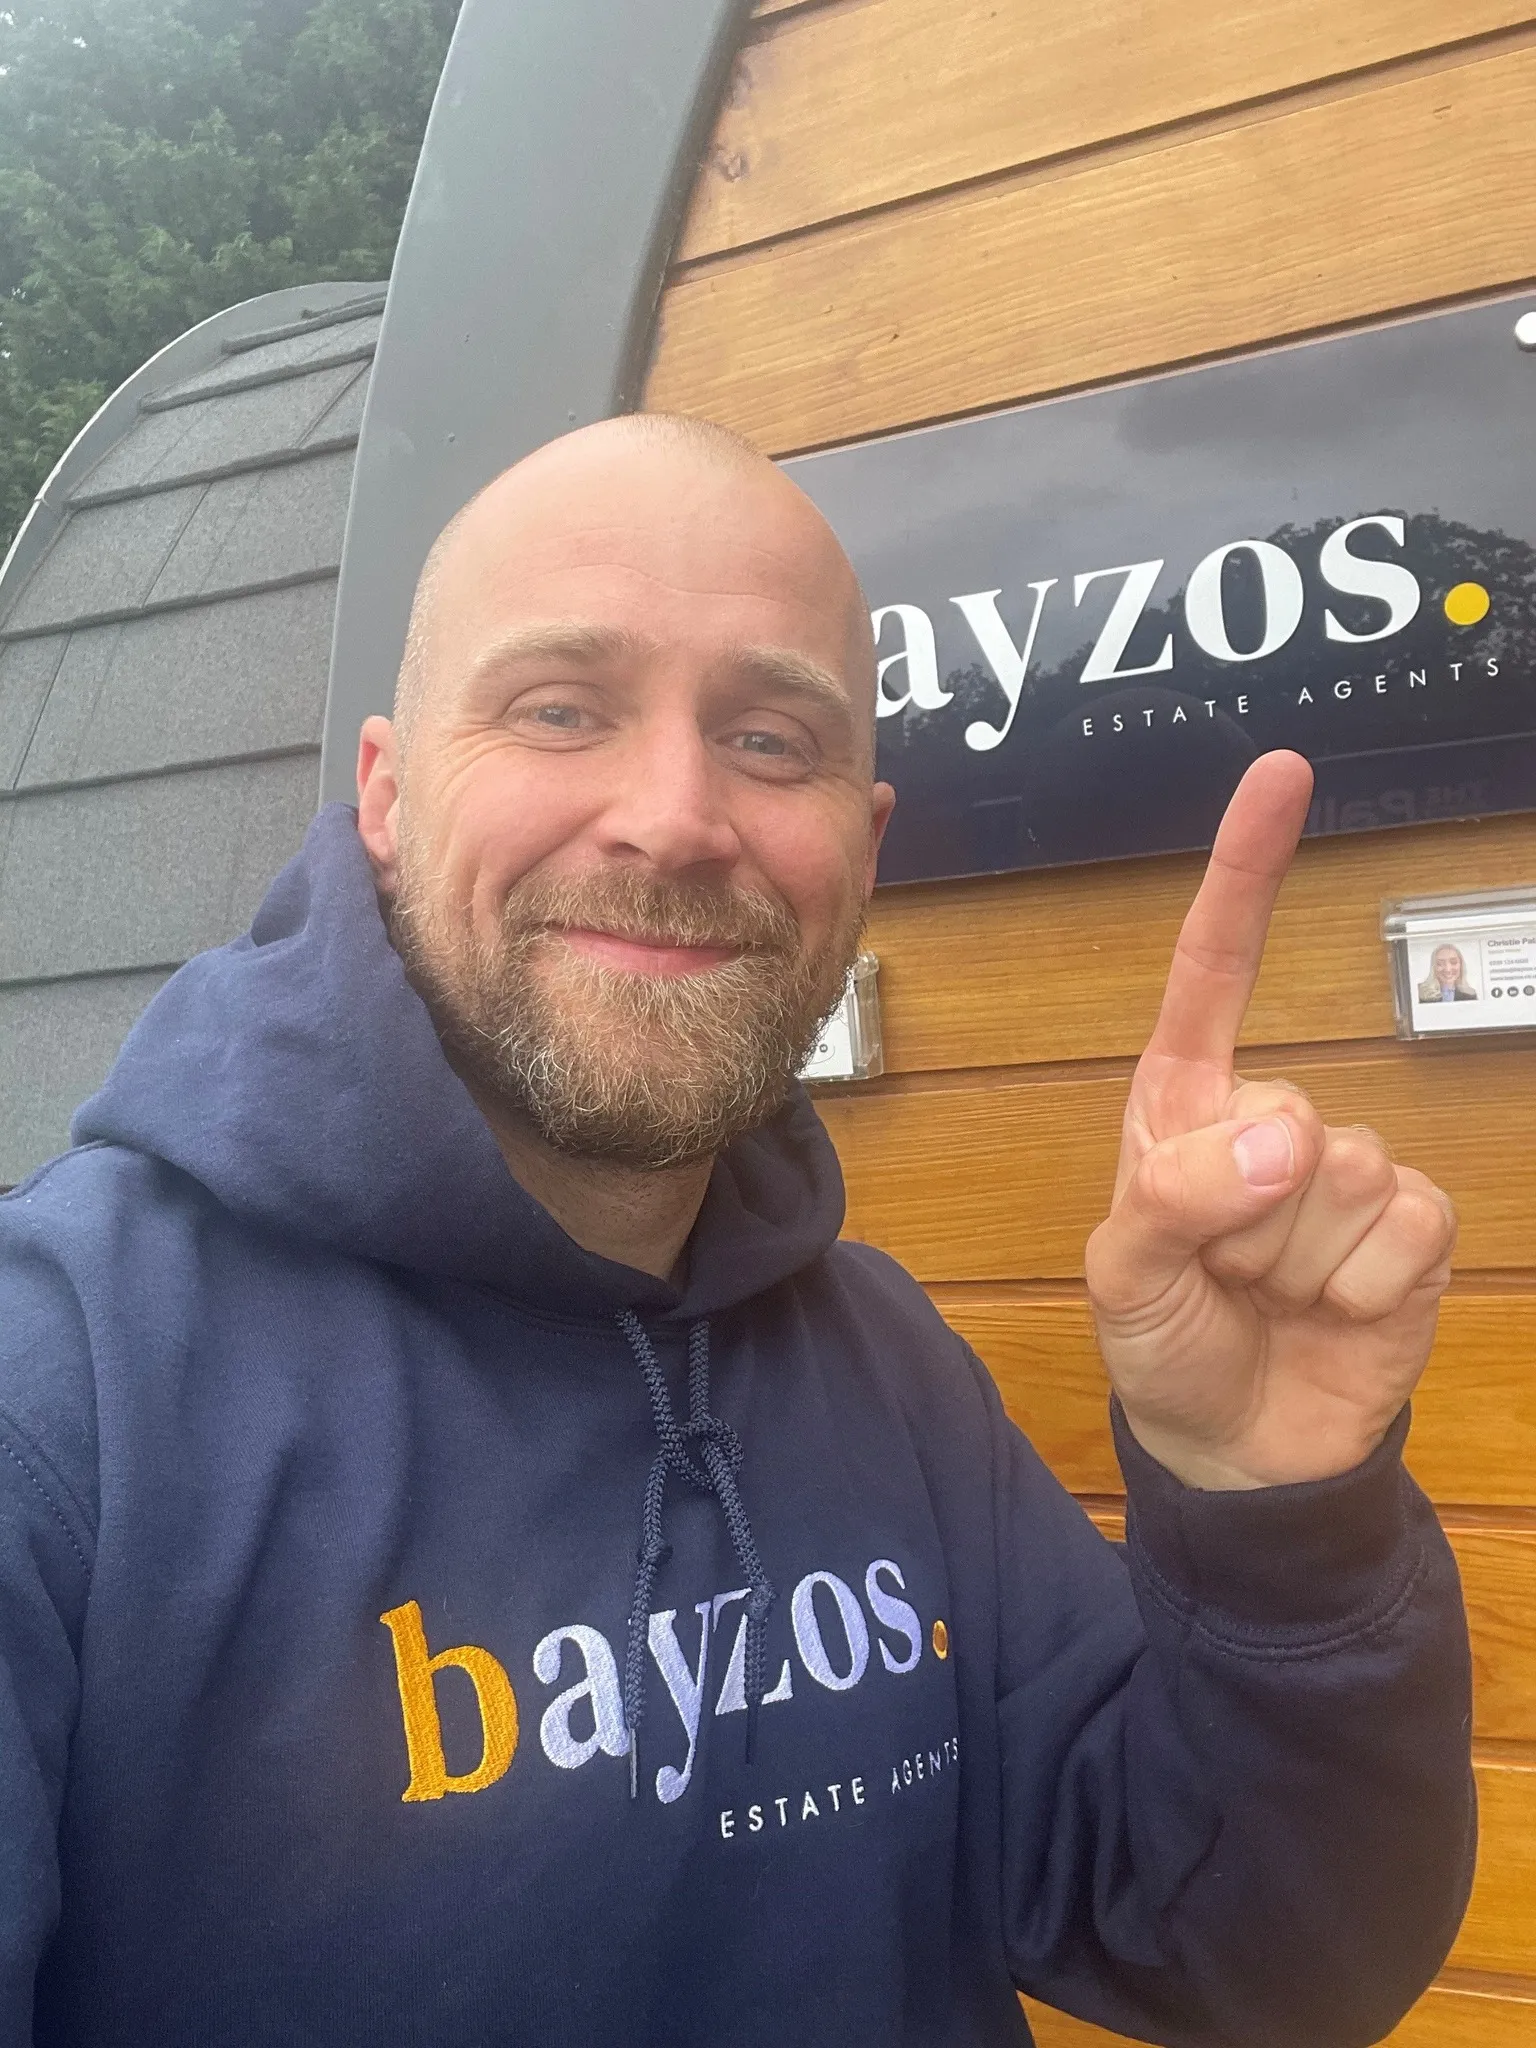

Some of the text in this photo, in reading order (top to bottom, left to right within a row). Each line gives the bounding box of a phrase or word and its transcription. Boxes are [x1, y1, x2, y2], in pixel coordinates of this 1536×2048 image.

[871, 515, 1491, 752] ayzos.
[1083, 657, 1499, 737] ESTATE AGENTS
[380, 1559, 948, 1804] bayzos.
[720, 1737, 959, 1839] ESTATE AGENTS
